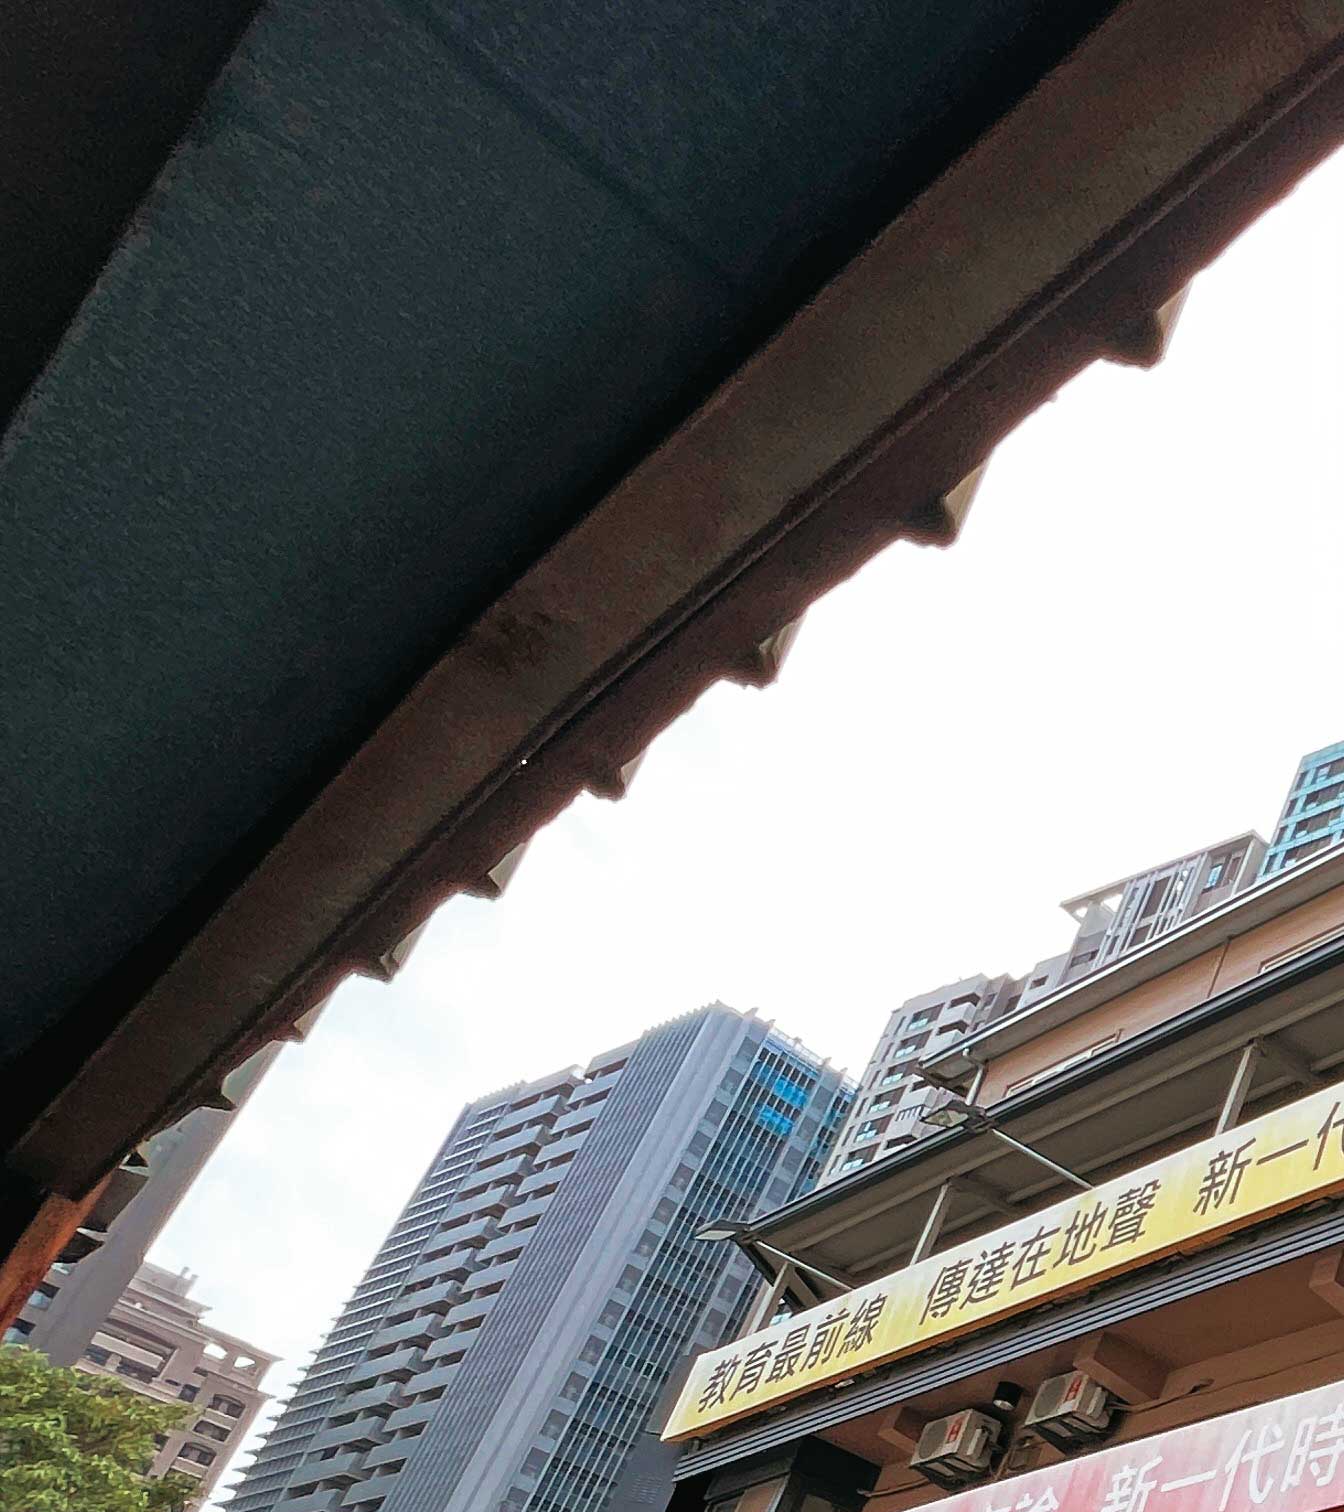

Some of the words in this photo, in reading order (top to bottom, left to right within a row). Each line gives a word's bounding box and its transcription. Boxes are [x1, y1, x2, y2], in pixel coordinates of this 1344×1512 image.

[698, 1293, 888, 1413] 教育最前線
[919, 1179, 1161, 1326] 傳達在地聲
